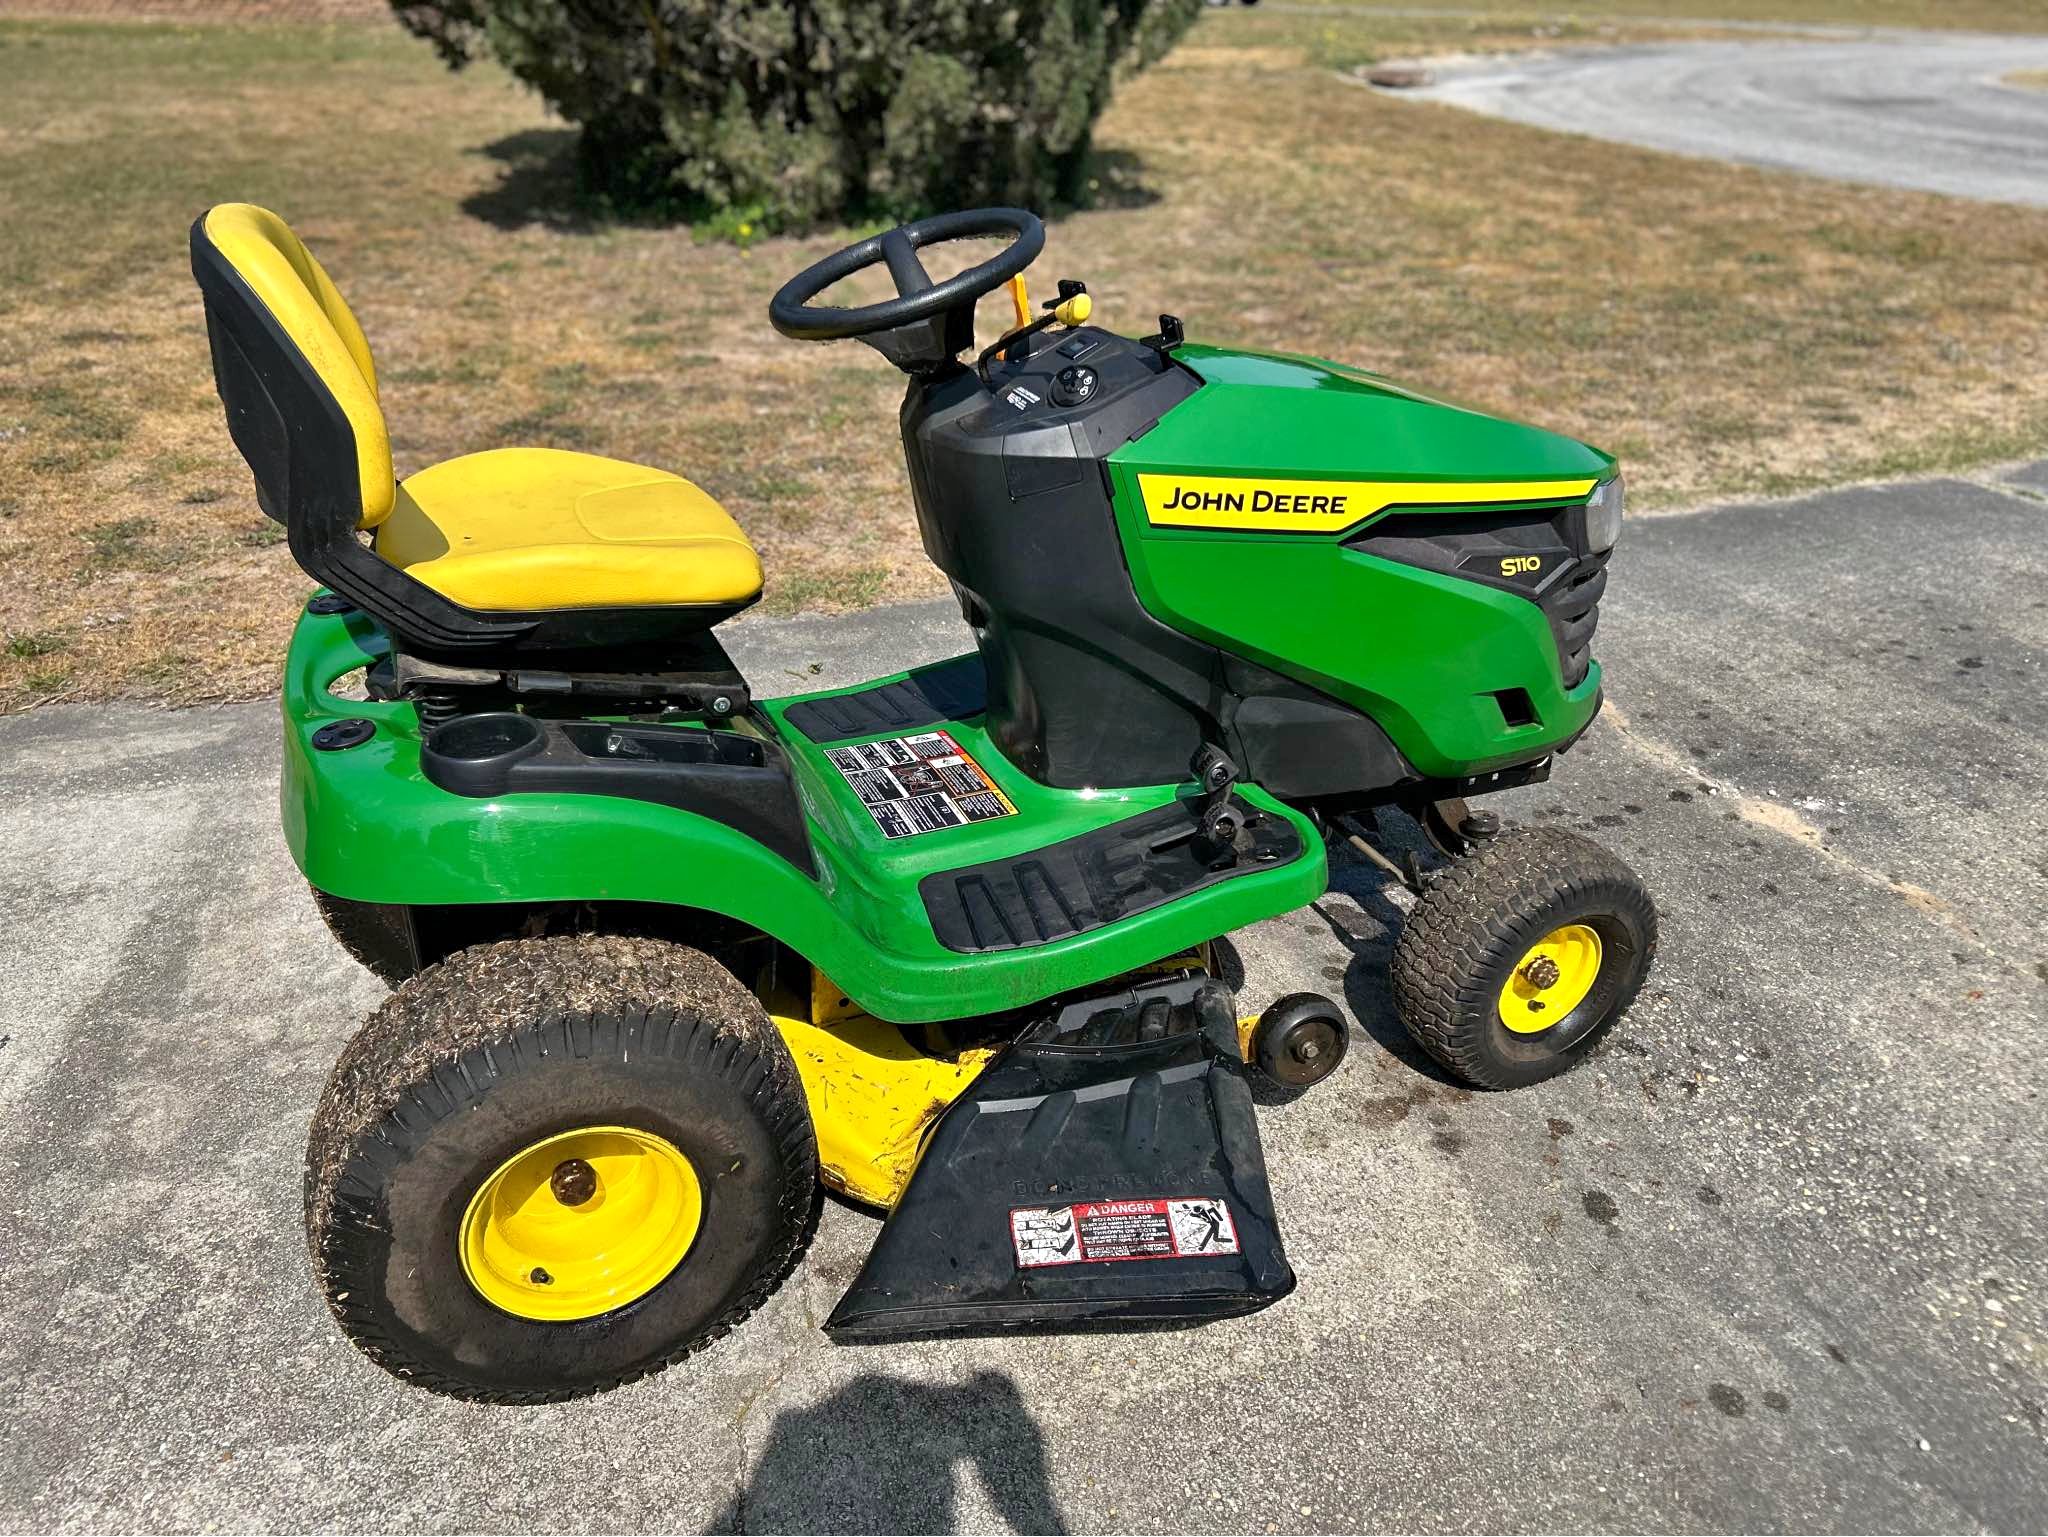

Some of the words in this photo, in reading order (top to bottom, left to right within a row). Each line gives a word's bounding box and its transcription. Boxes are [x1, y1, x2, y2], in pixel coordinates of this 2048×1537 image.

[1163, 487, 1245, 512] JOHN
[1251, 490, 1347, 514] DEERE
[1500, 555, 1541, 577] S110
[1101, 1203, 1155, 1215] DANGER
